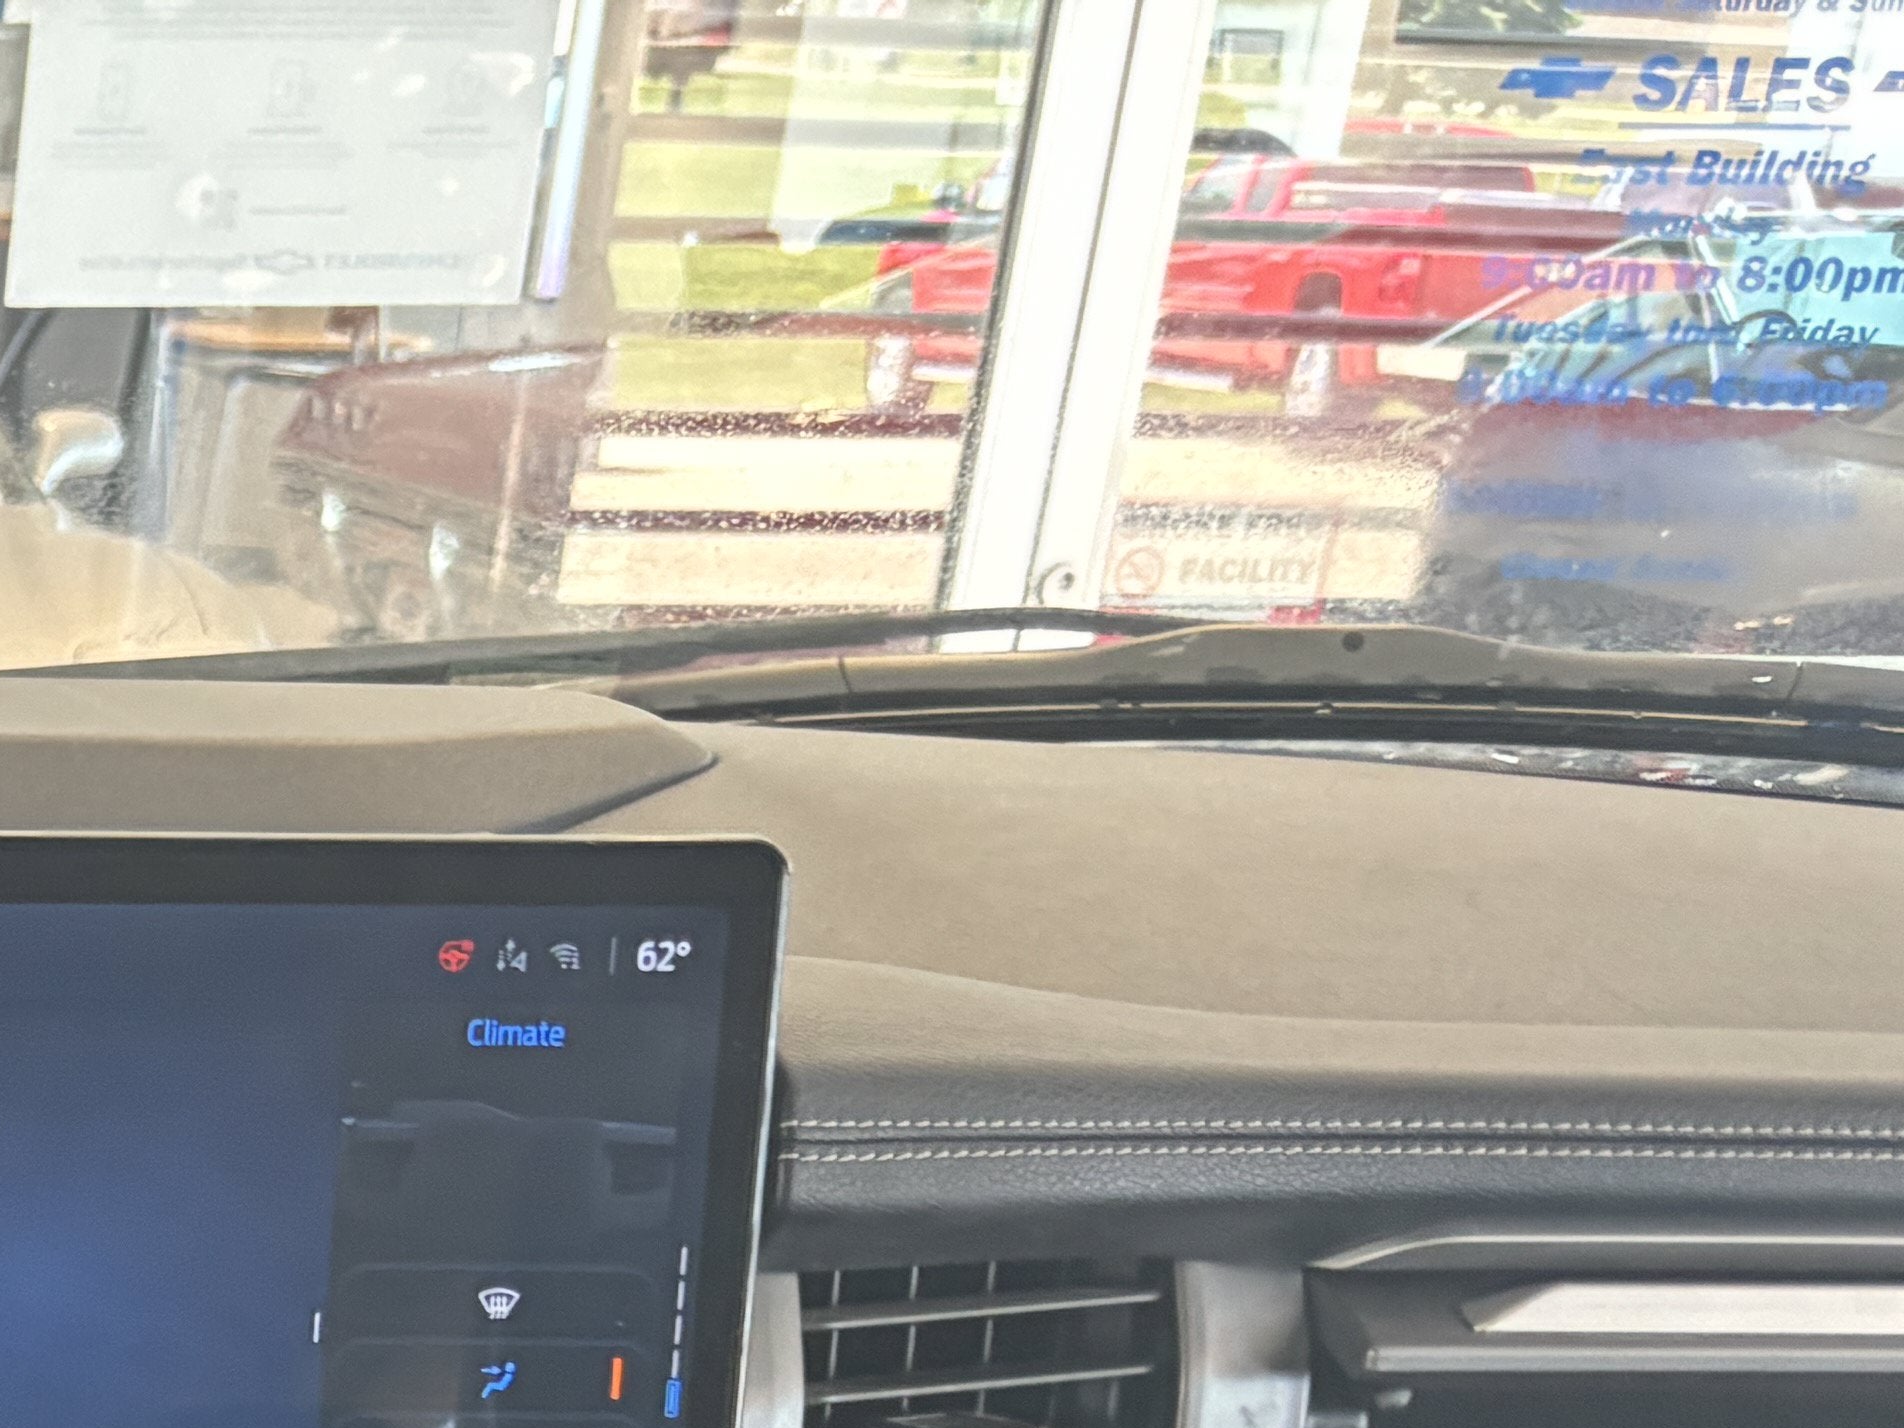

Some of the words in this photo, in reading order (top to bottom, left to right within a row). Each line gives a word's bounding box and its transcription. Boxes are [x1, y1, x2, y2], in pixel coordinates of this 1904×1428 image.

[1632, 53, 1855, 114] SALES
[1687, 149, 1876, 194] Building
[1737, 255, 1904, 302] 8:00pm
[1758, 317, 1881, 348] Friday
[1178, 558, 1316, 585] FACILITY
[635, 939, 691, 973] 62°
[466, 1018, 565, 1048] Climate
